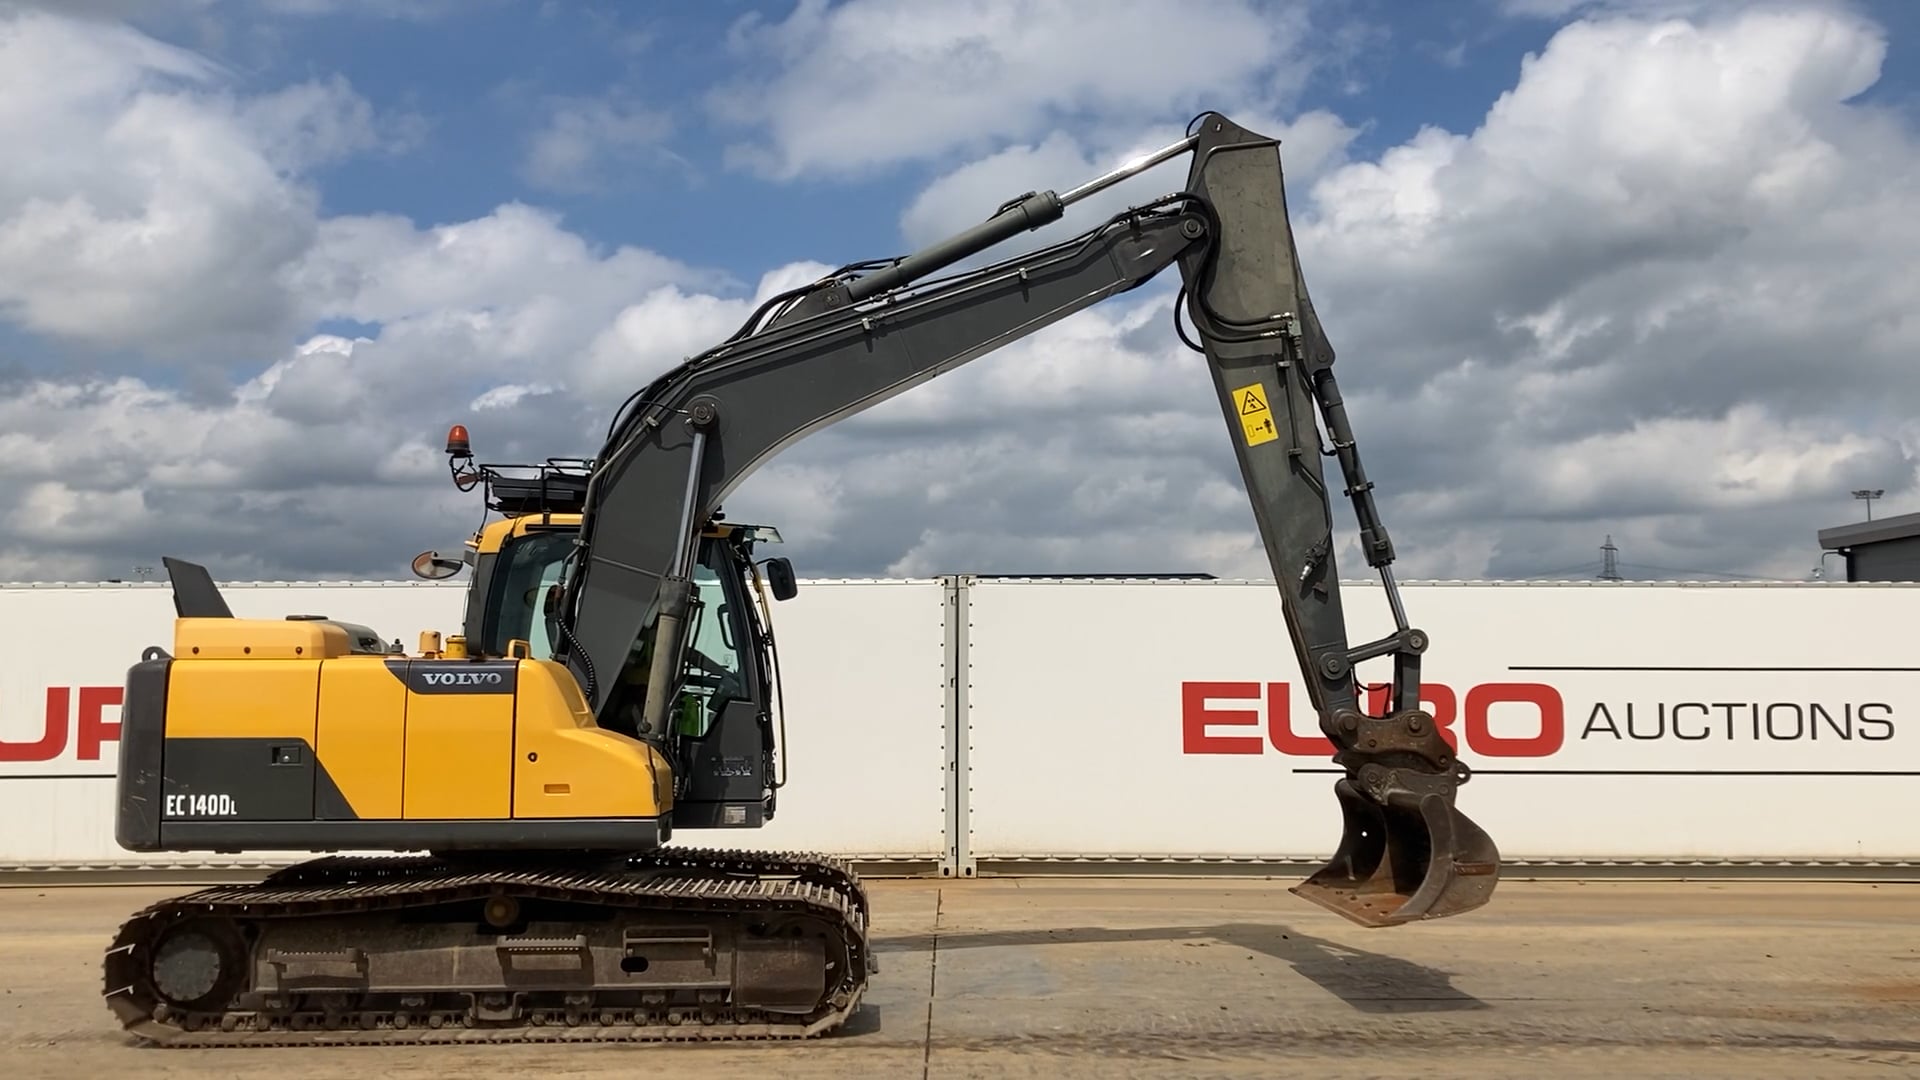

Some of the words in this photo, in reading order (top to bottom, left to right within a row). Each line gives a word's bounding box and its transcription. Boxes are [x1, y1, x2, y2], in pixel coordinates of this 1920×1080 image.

[422, 672, 502, 685] VOLVO
[1580, 702, 1895, 741] AUCTIONS
[166, 794, 186, 816] EC
